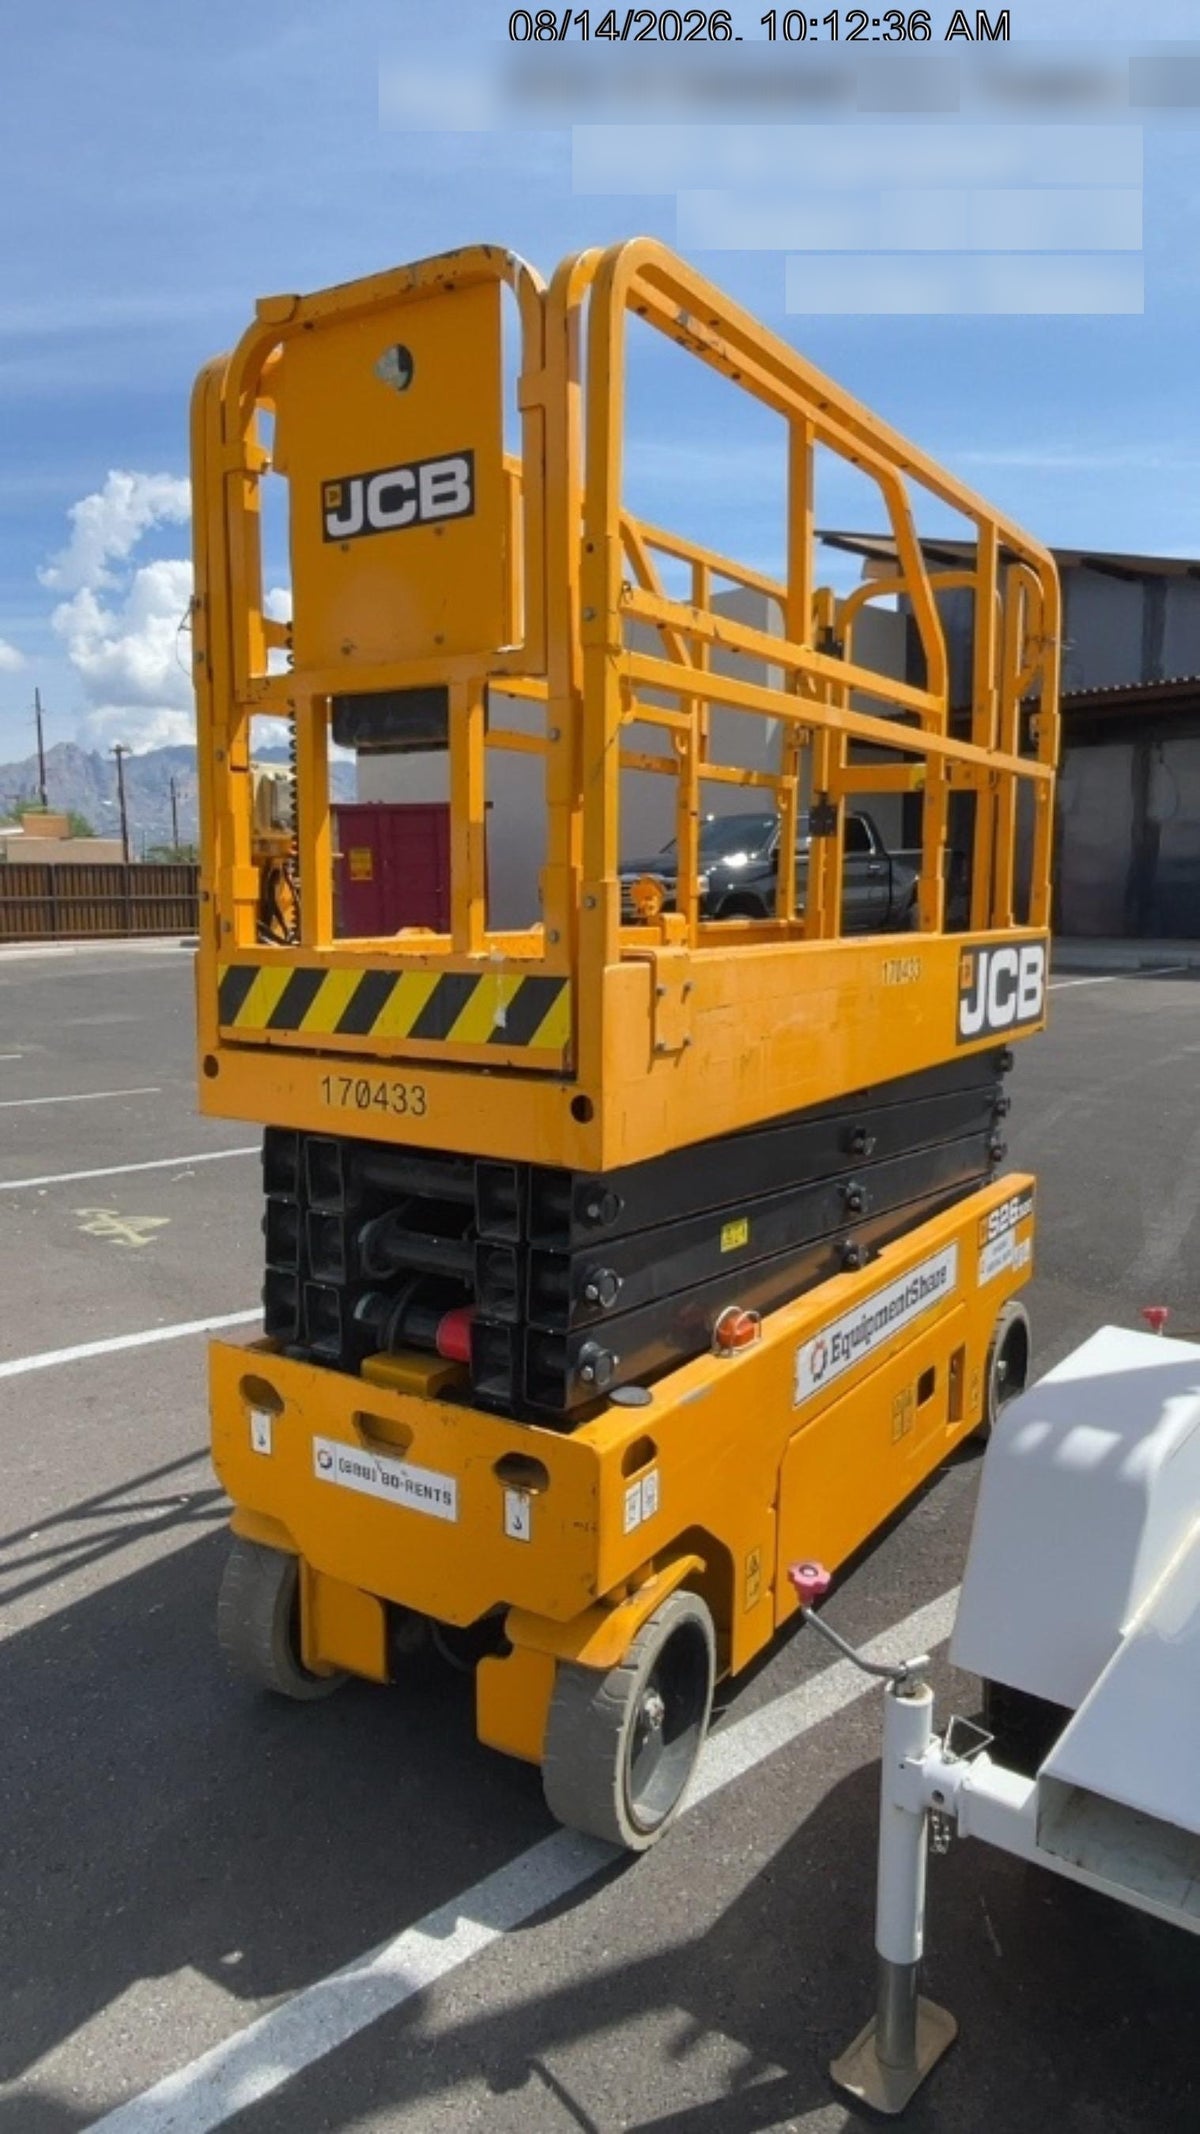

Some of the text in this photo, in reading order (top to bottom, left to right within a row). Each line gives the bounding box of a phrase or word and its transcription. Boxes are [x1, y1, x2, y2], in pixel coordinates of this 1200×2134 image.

[325, 458, 471, 537] JCB
[960, 945, 1044, 1034] JCB
[322, 1075, 427, 1116] 170433
[830, 1264, 948, 1364] EquipmentShare
